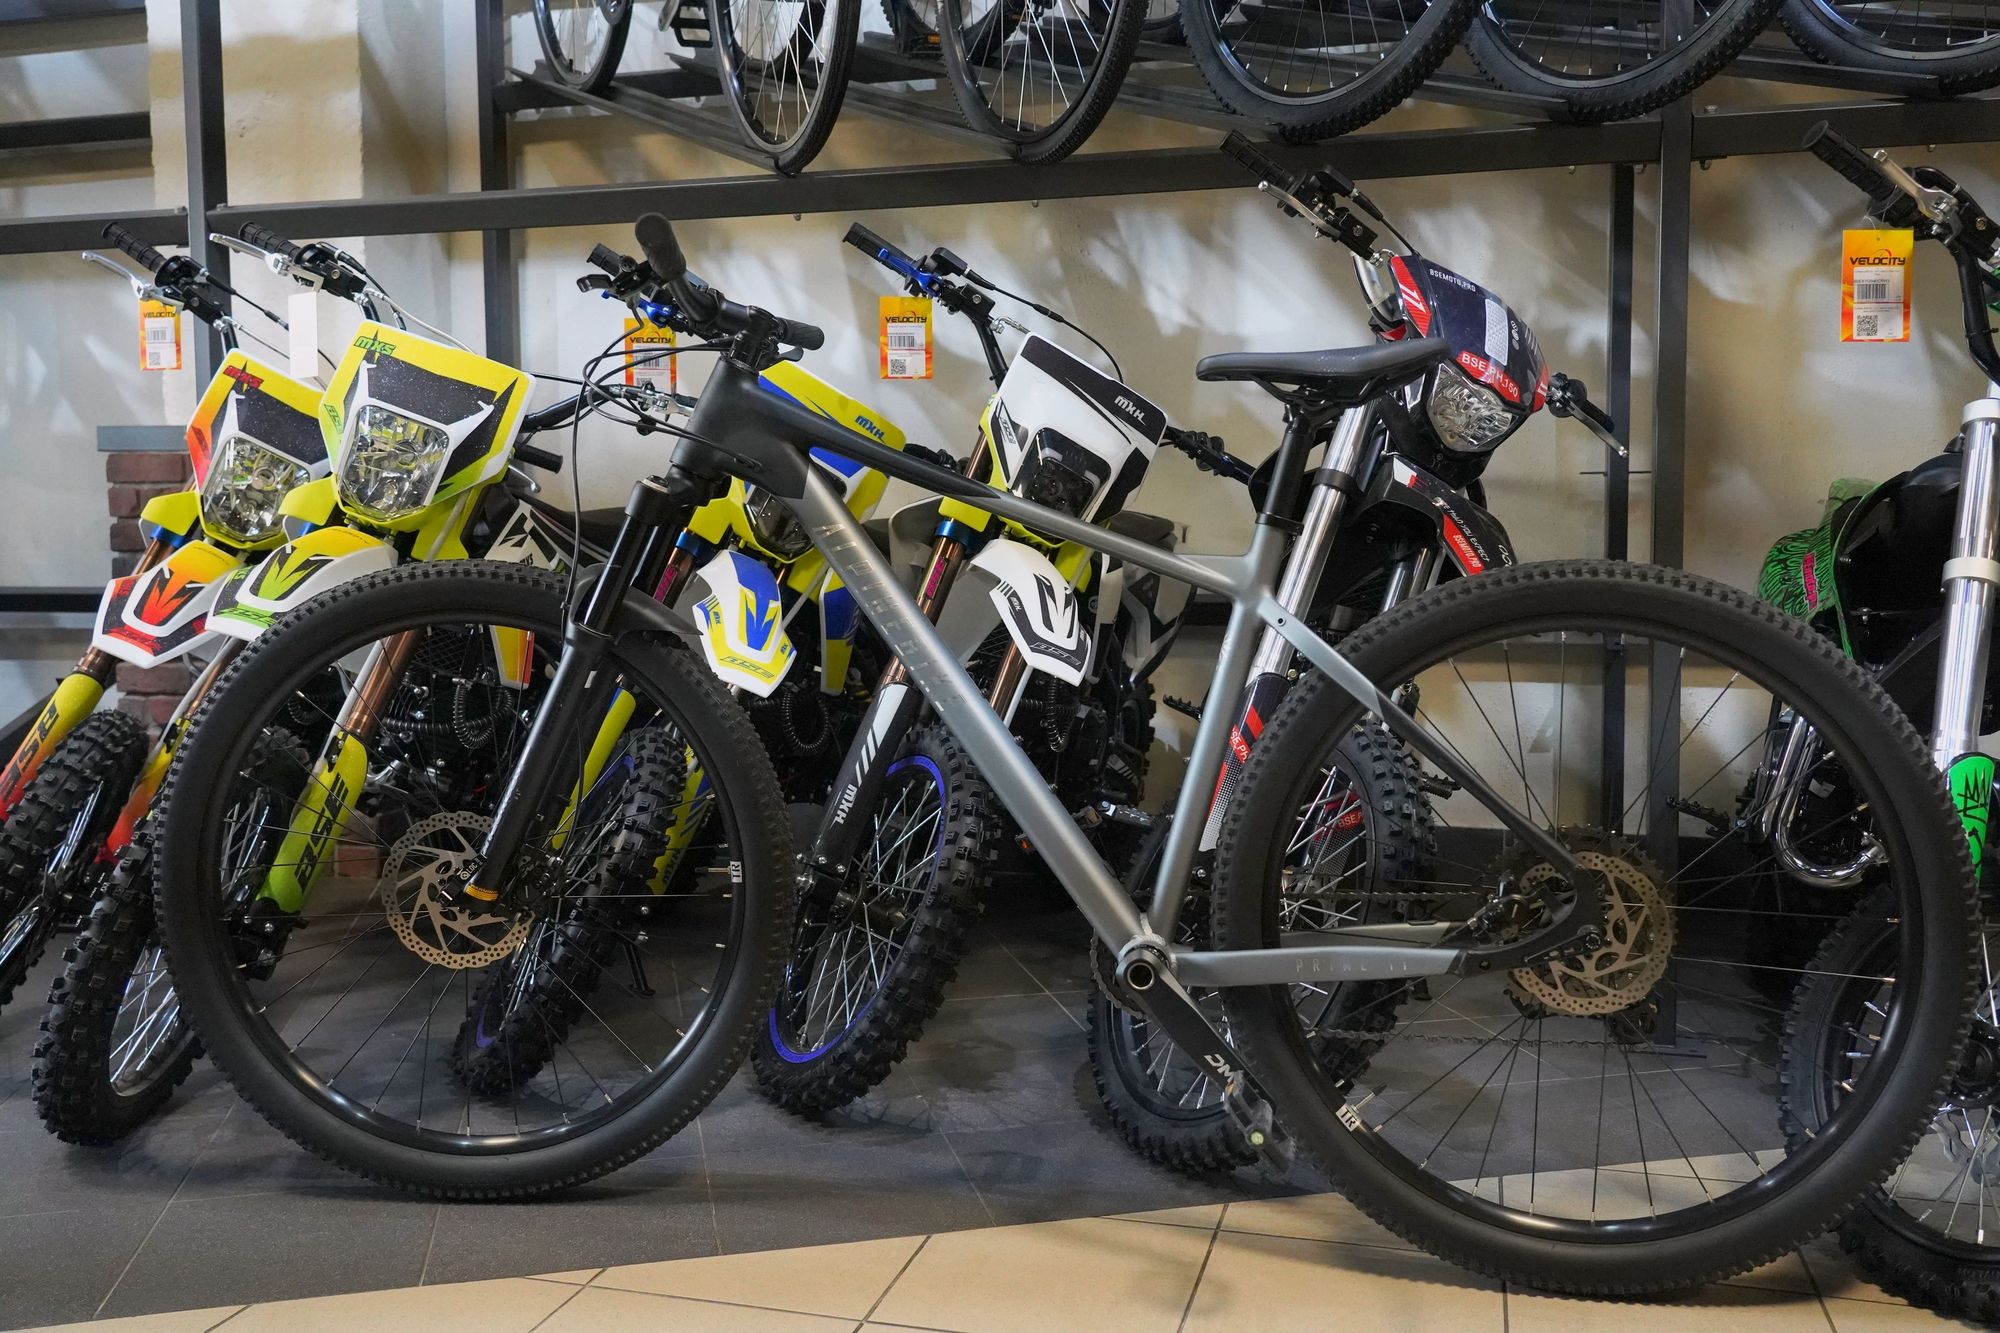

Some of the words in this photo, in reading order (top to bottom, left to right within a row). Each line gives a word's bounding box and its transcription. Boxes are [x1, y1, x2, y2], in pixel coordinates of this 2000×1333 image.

[1850, 257, 1905, 265] VELOCITY
[1429, 269, 1476, 292] BSEMOTO.PRO
[1113, 396, 1146, 425] MXH
[830, 783, 858, 829] MXH
[731, 864, 741, 881] TR
[1340, 1107, 1358, 1128] TR
